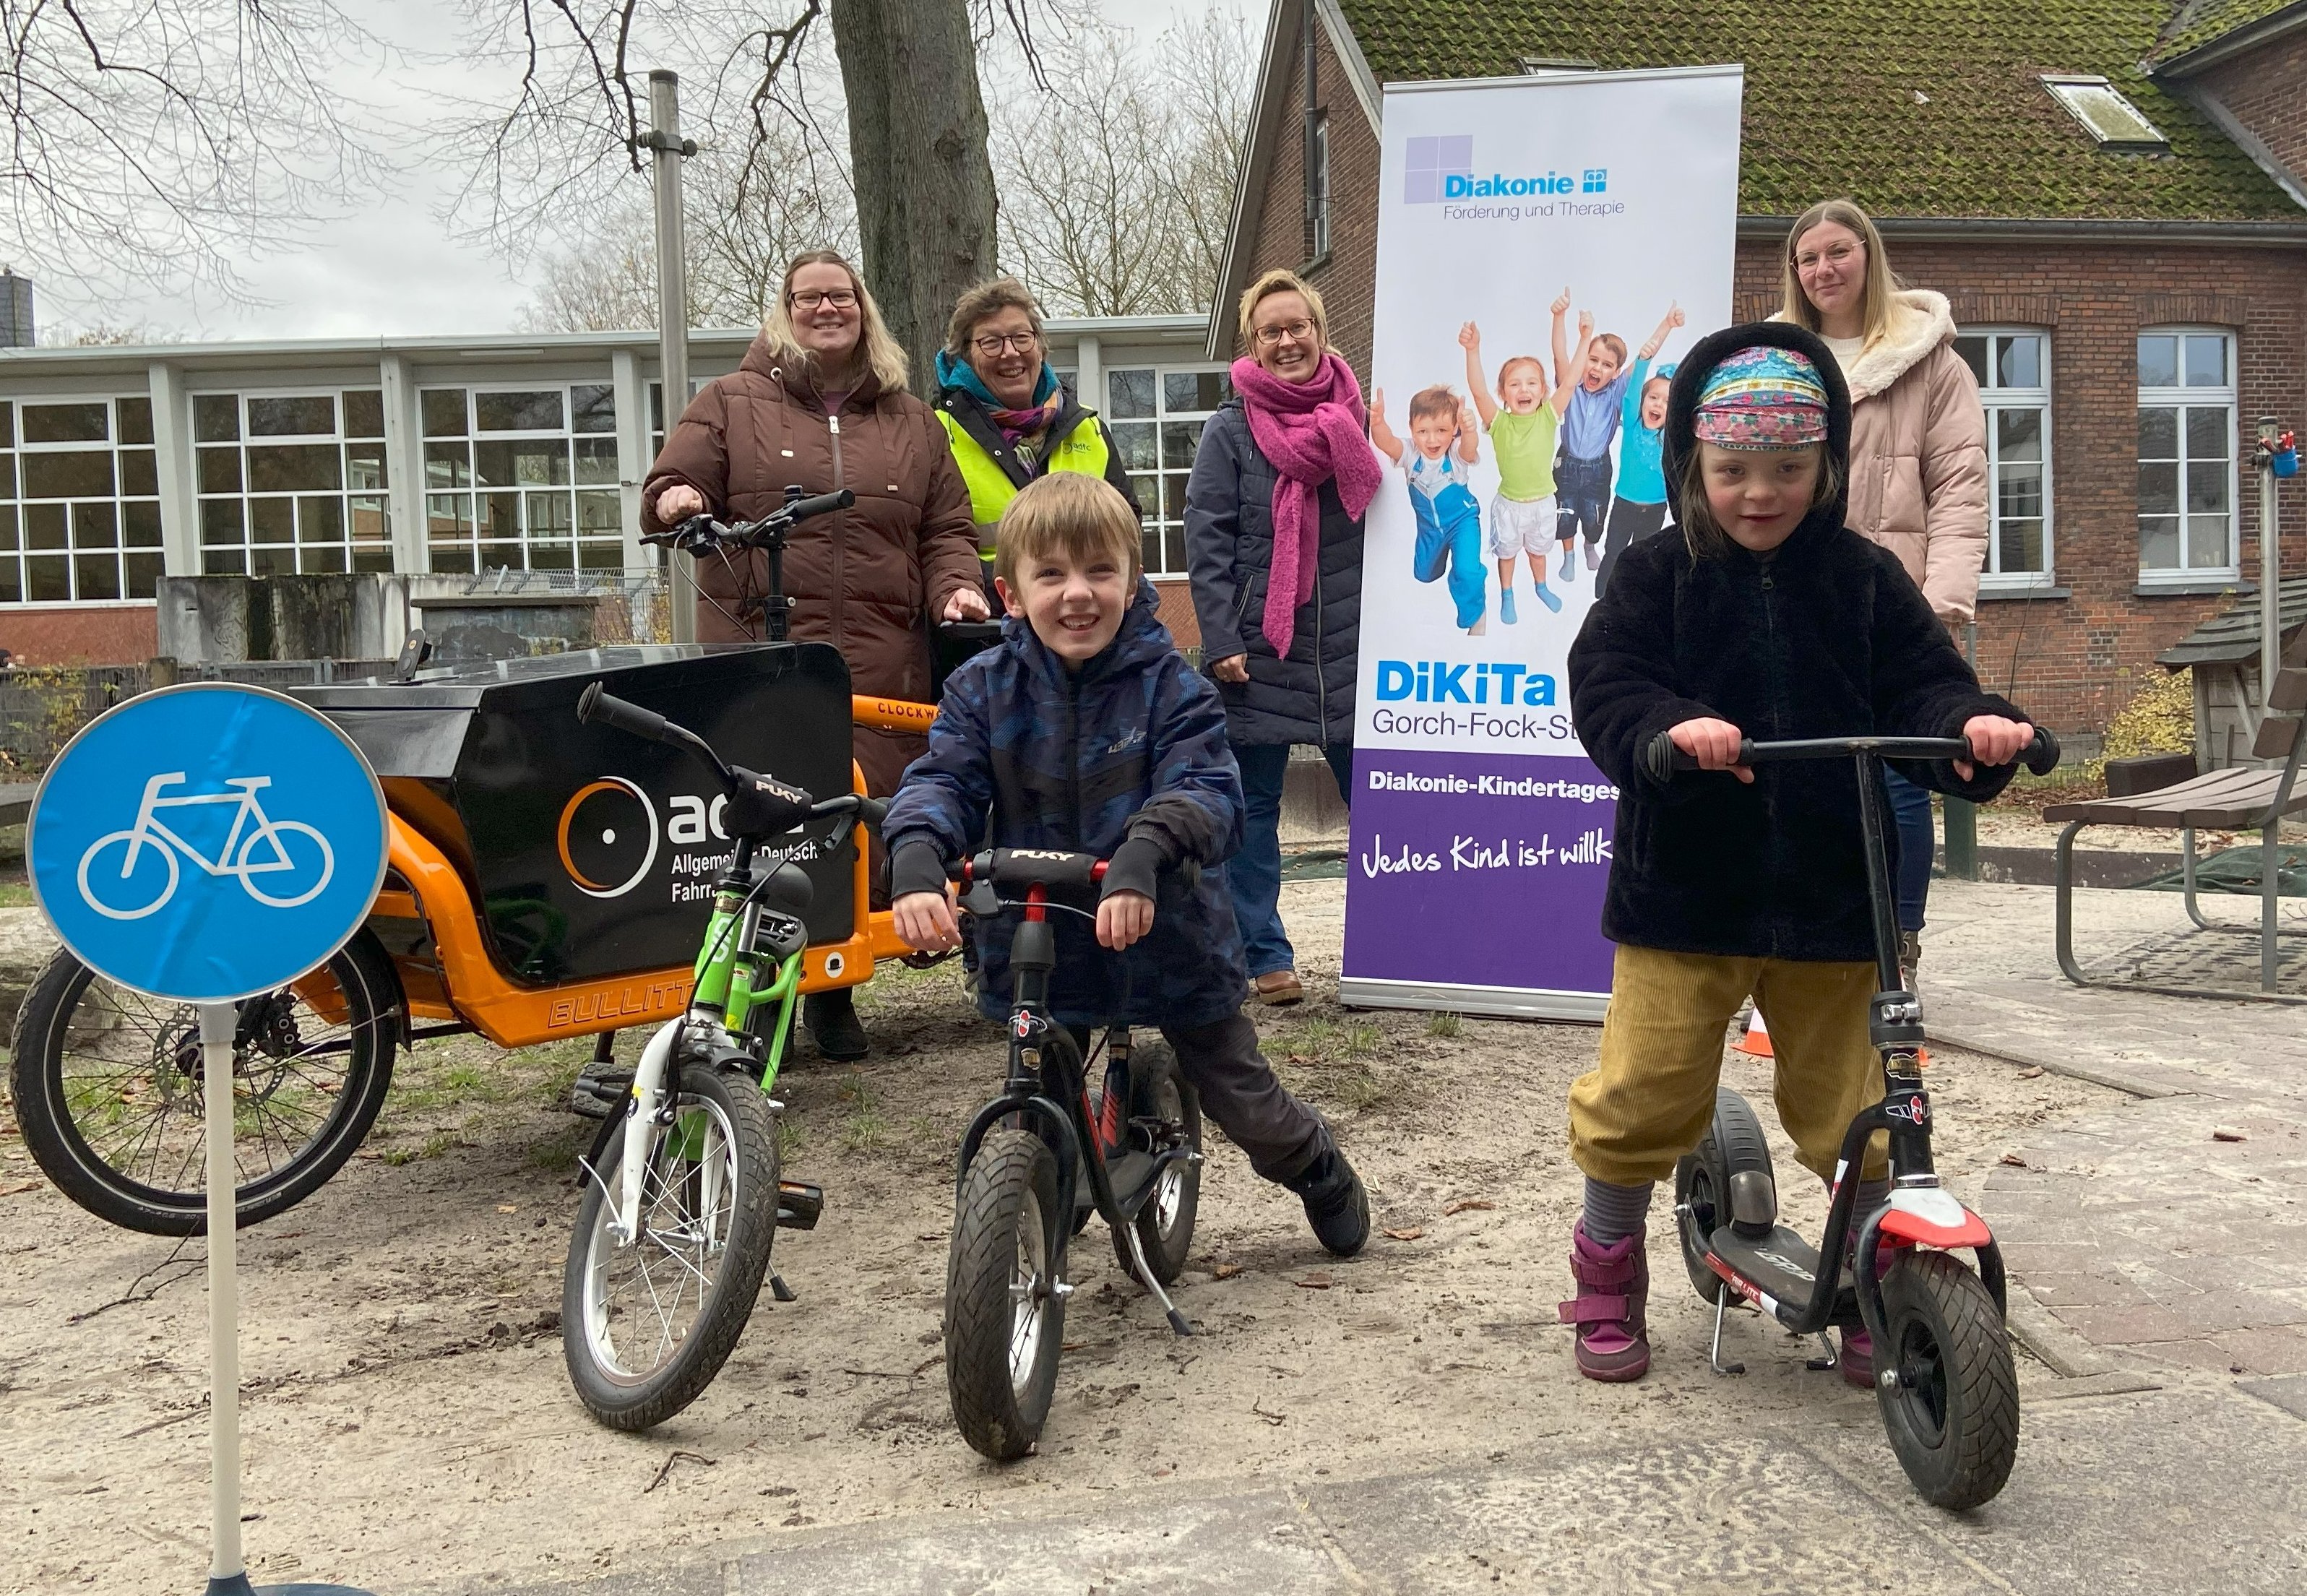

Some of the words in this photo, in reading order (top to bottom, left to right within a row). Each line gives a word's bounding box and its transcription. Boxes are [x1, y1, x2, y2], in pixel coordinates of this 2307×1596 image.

[1446, 171, 1574, 198] Diakonie
[1444, 204, 1519, 221] Förderung
[1525, 202, 1553, 217] und
[1558, 200, 1625, 218] Therapie
[1376, 660, 1556, 706] DiKiTa
[1369, 770, 1620, 803] Diakonie-Kindertages
[1362, 834, 1441, 879] Jedes
[1450, 835, 1510, 871] Kind
[1518, 833, 1555, 867] ist
[548, 978, 695, 1028] BULLITT
